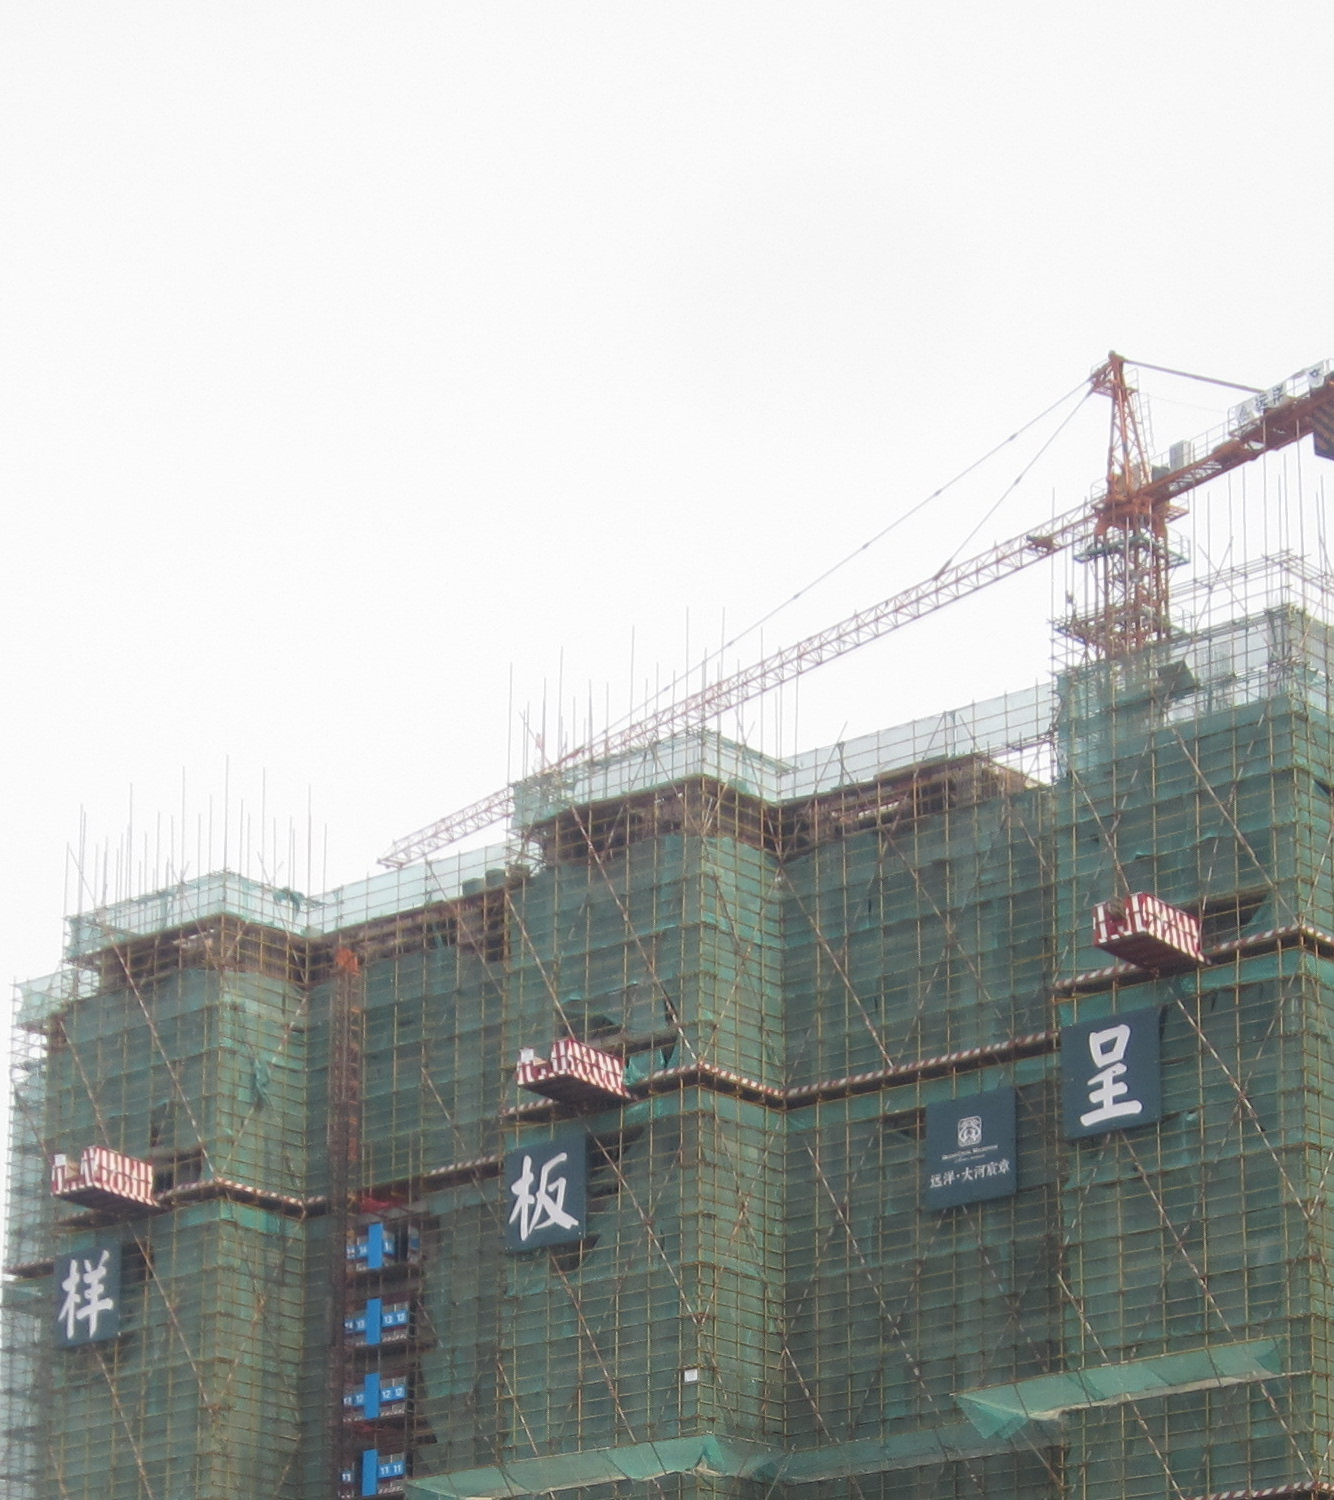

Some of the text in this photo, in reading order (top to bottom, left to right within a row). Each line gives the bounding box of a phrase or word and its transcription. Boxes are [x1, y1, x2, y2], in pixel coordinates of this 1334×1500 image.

[1080, 1024, 1142, 1127] 呈
[508, 1152, 579, 1241] 板
[58, 1249, 114, 1339] 样
